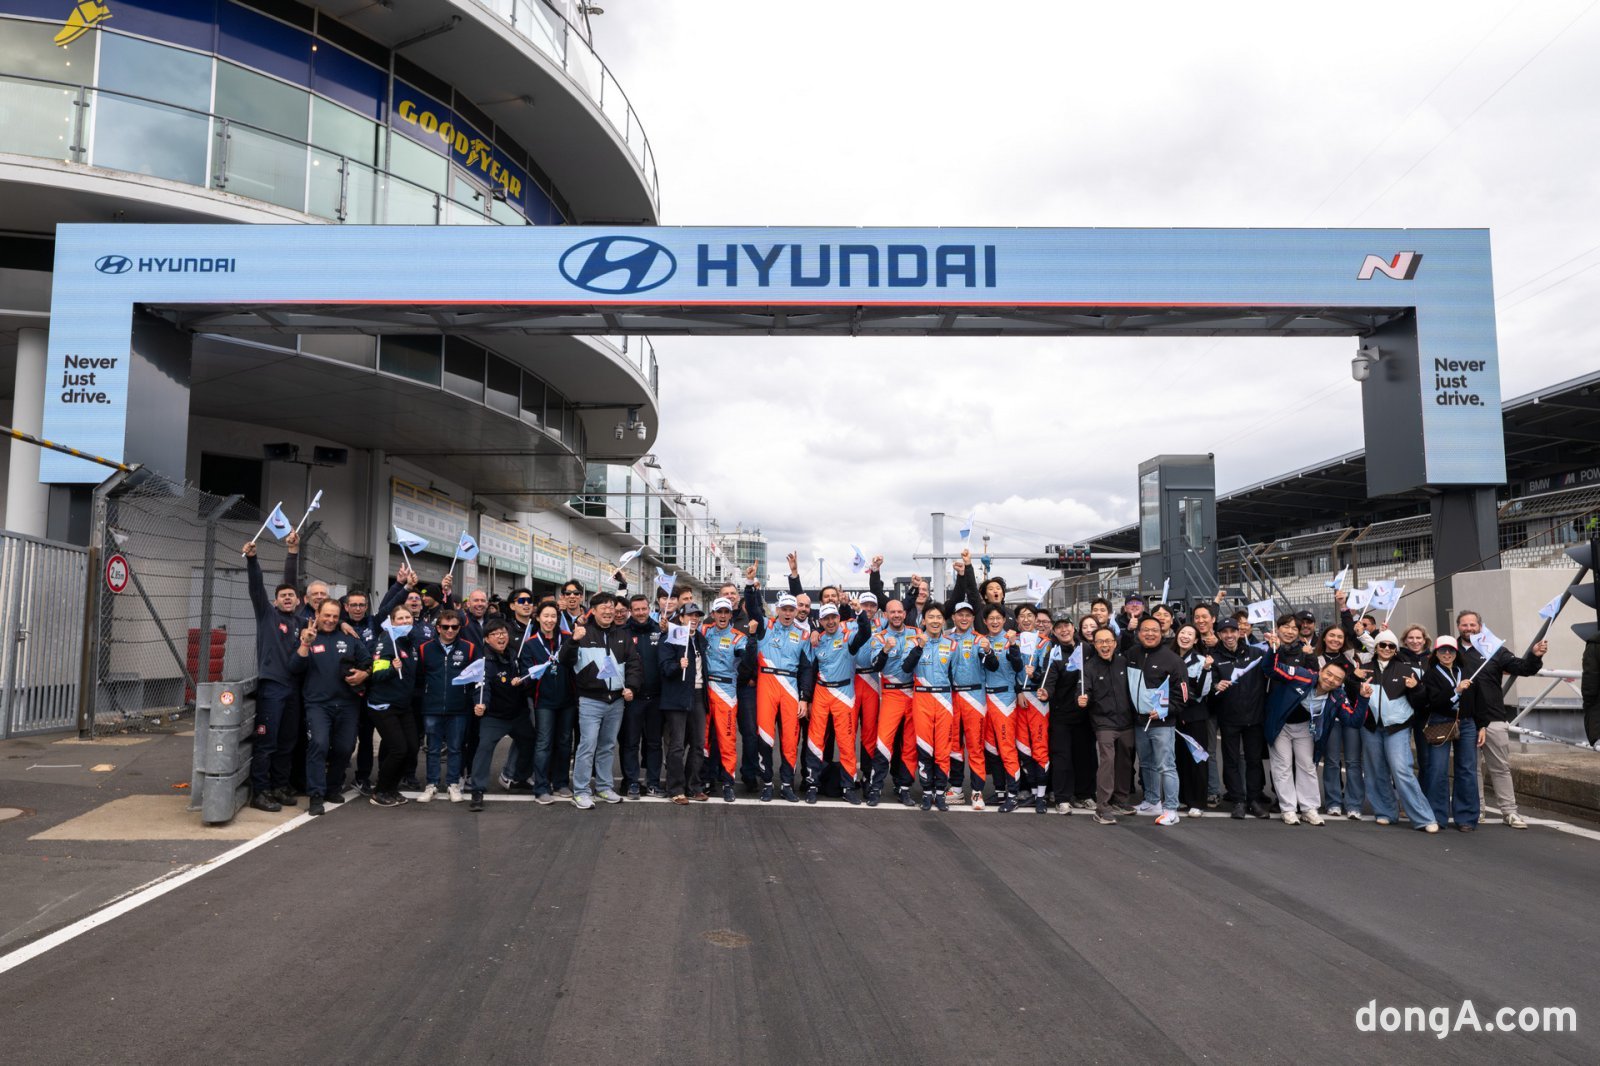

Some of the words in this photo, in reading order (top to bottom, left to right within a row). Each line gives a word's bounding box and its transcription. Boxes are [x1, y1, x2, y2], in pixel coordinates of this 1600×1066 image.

[399, 100, 522, 199] GOODYEAR
[138, 258, 236, 273] HYUNDAI
[697, 244, 996, 288] HYUNDAI
[64, 354, 118, 369] Never
[1434, 357, 1486, 372] Never
[62, 370, 96, 389] just
[1435, 374, 1468, 391] just
[61, 388, 111, 405] drive.
[1436, 391, 1485, 406] drive.
[1529, 478, 1550, 492] BMW
